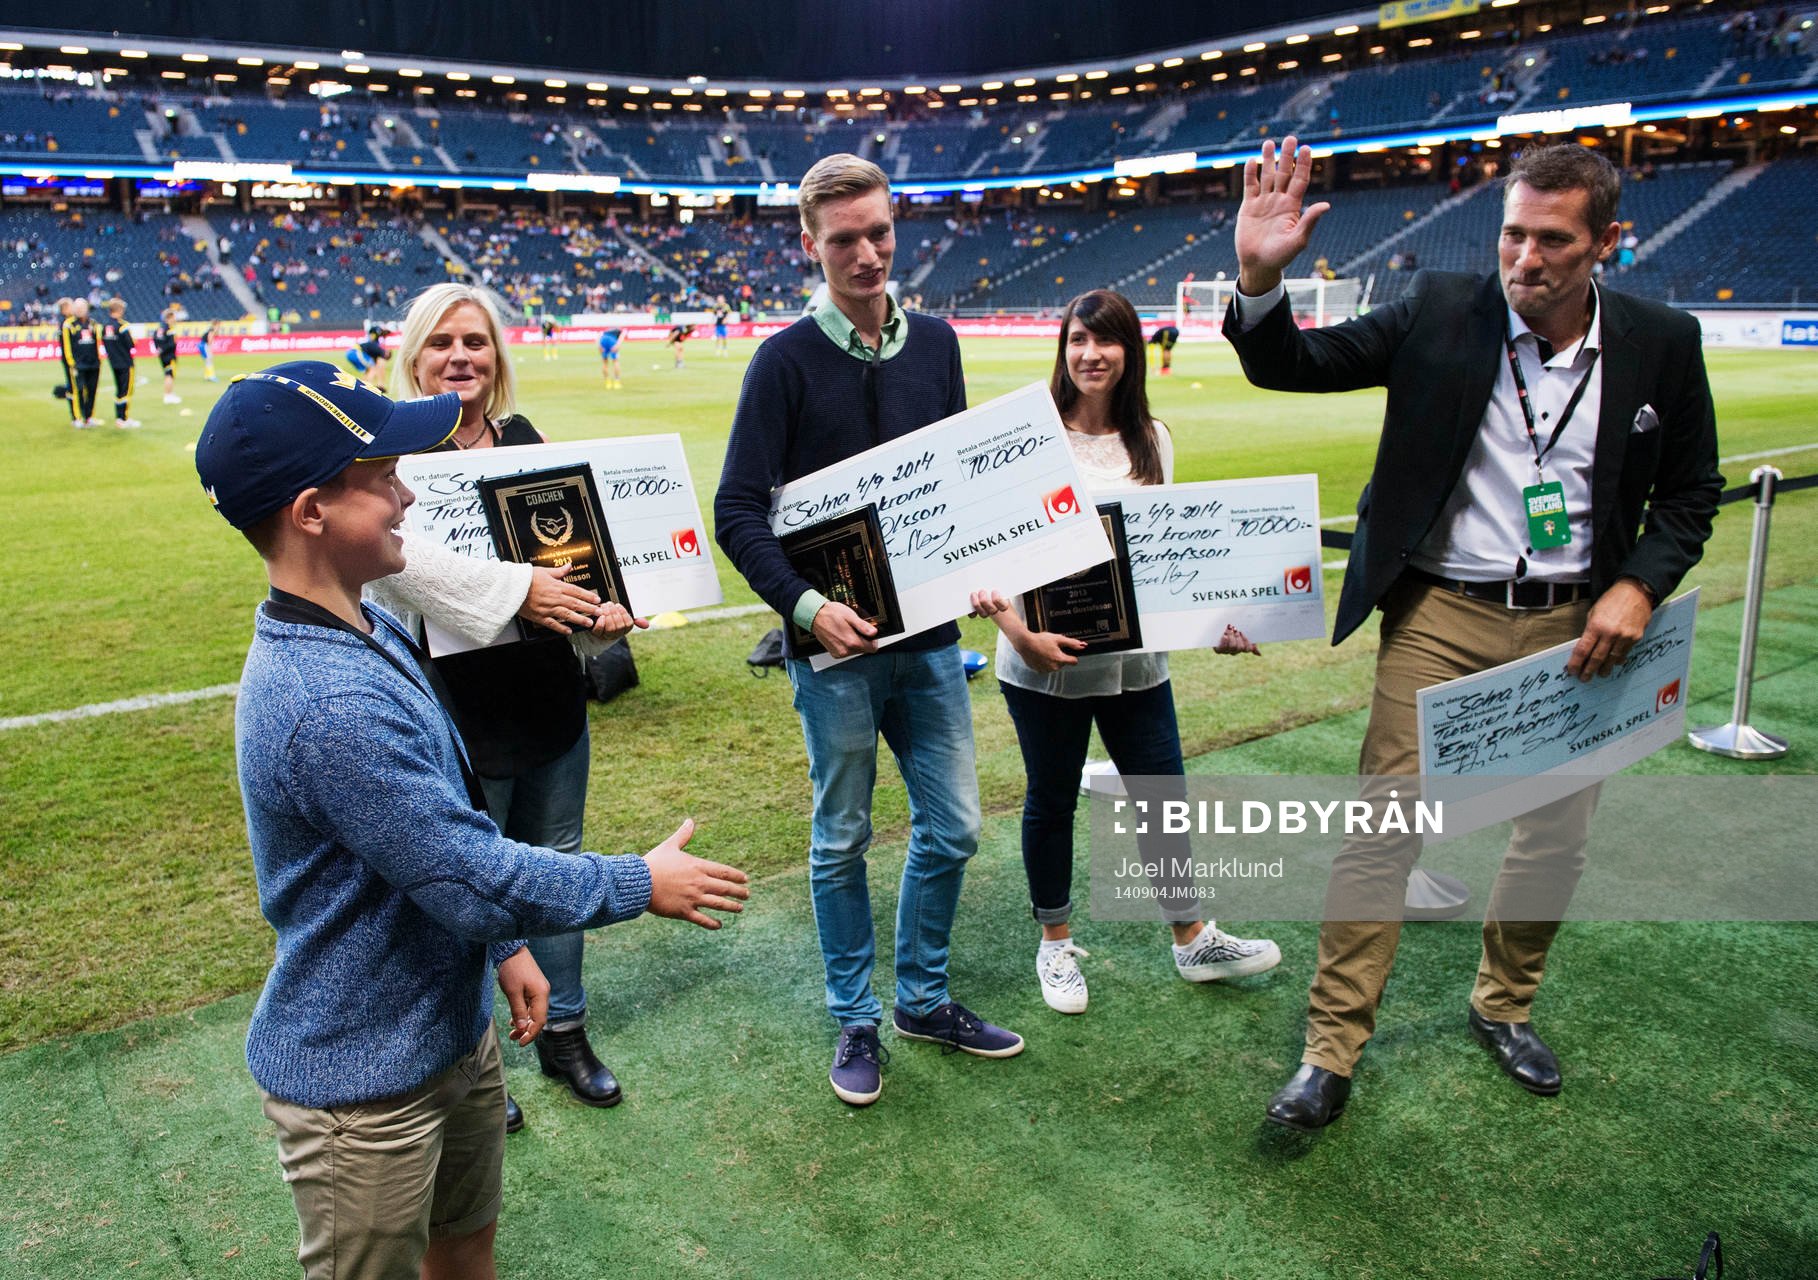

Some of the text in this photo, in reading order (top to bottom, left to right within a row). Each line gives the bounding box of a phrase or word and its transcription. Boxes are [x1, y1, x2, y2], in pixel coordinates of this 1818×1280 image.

[957, 422, 1032, 456] Betala mot denna check
[969, 436, 1056, 480] 10.000:-
[525, 489, 565, 506] COACHEN
[783, 451, 935, 526] Solna 4/9 2014
[877, 480, 943, 512] kronor
[783, 500, 802, 512] datum
[1148, 502, 1175, 528] 4/9
[1180, 501, 1223, 519] 2014
[943, 533, 1007, 565] SVENSKA
[1009, 519, 1044, 539] SPEL
[1158, 526, 1222, 543] kronor
[643, 550, 672, 564] SPEL
[564, 572, 591, 583] Nilsson
[1192, 585, 1280, 602] SVENSKA SPEL
[1519, 670, 1550, 700] 4/9
[1569, 724, 1623, 754] SVENSKA
[1625, 710, 1652, 729] SPEL
